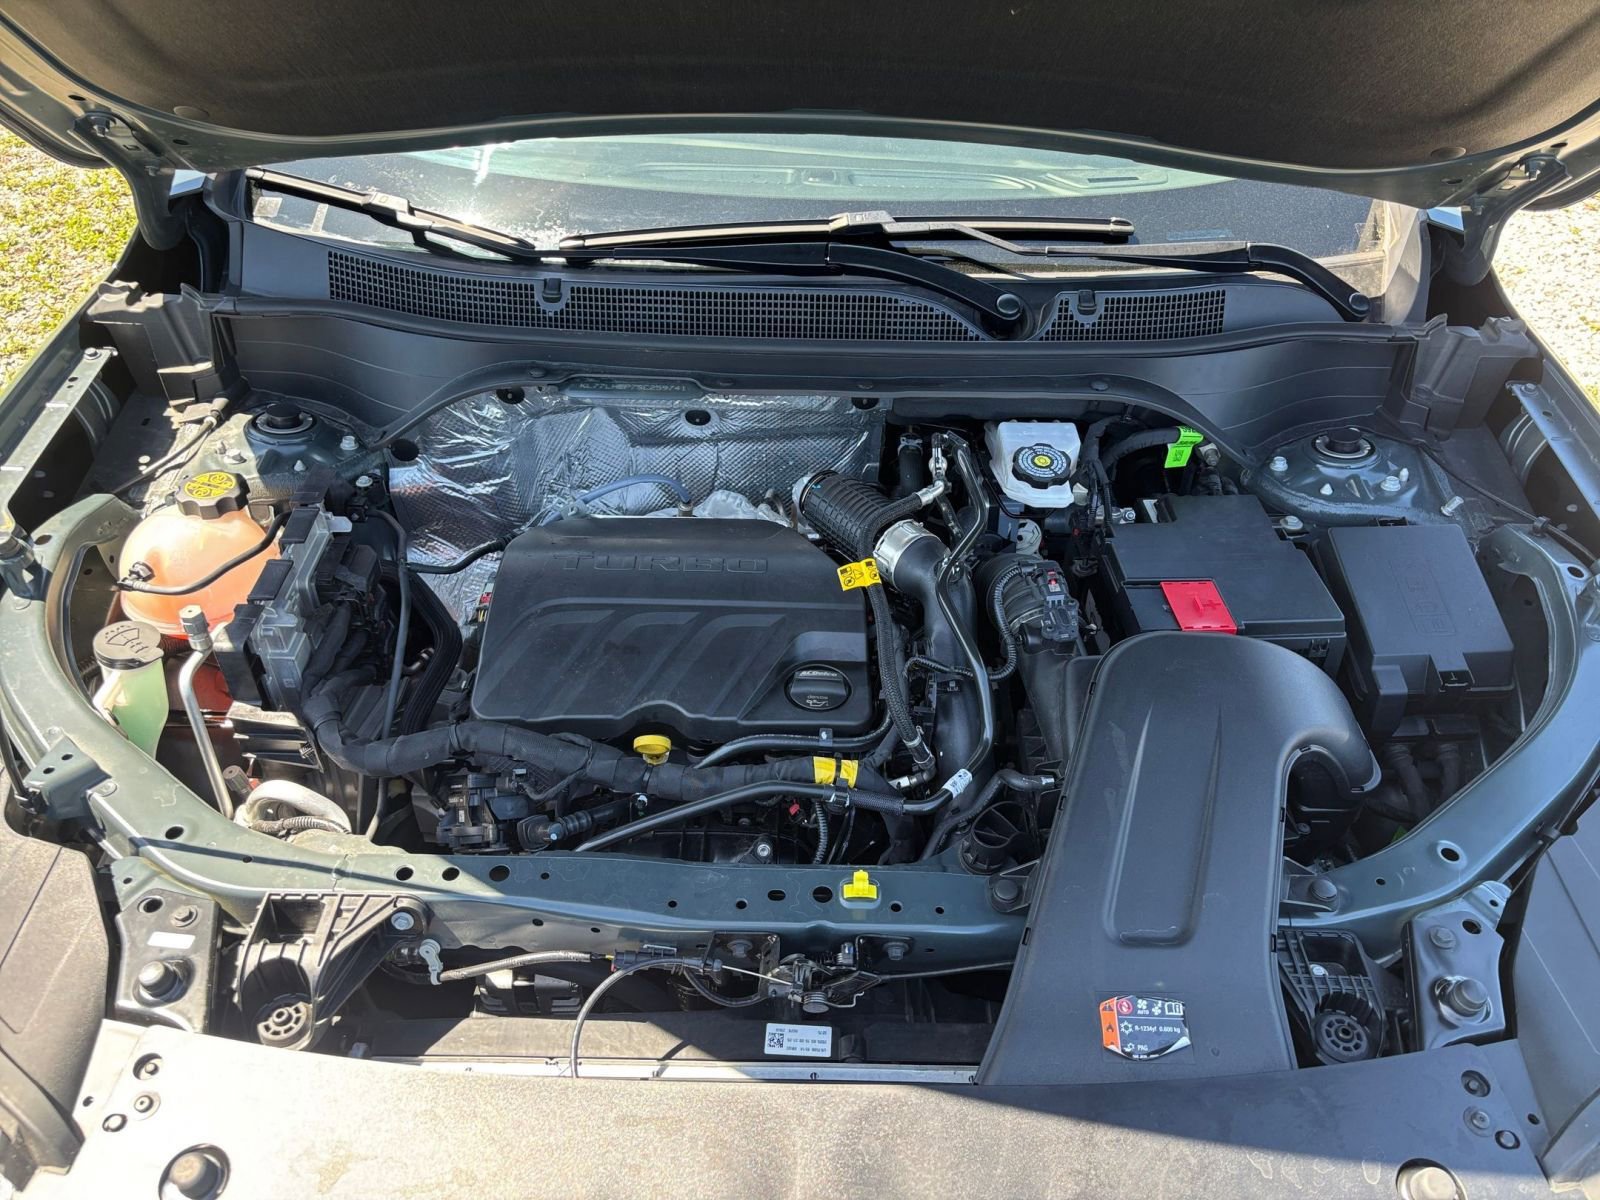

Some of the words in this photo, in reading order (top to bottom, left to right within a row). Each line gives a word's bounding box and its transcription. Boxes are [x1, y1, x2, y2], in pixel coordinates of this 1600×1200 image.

[553, 552, 768, 573] TURBO
[1134, 1025, 1157, 1033] R-1234yf
[1173, 1026, 1181, 1034] kg
